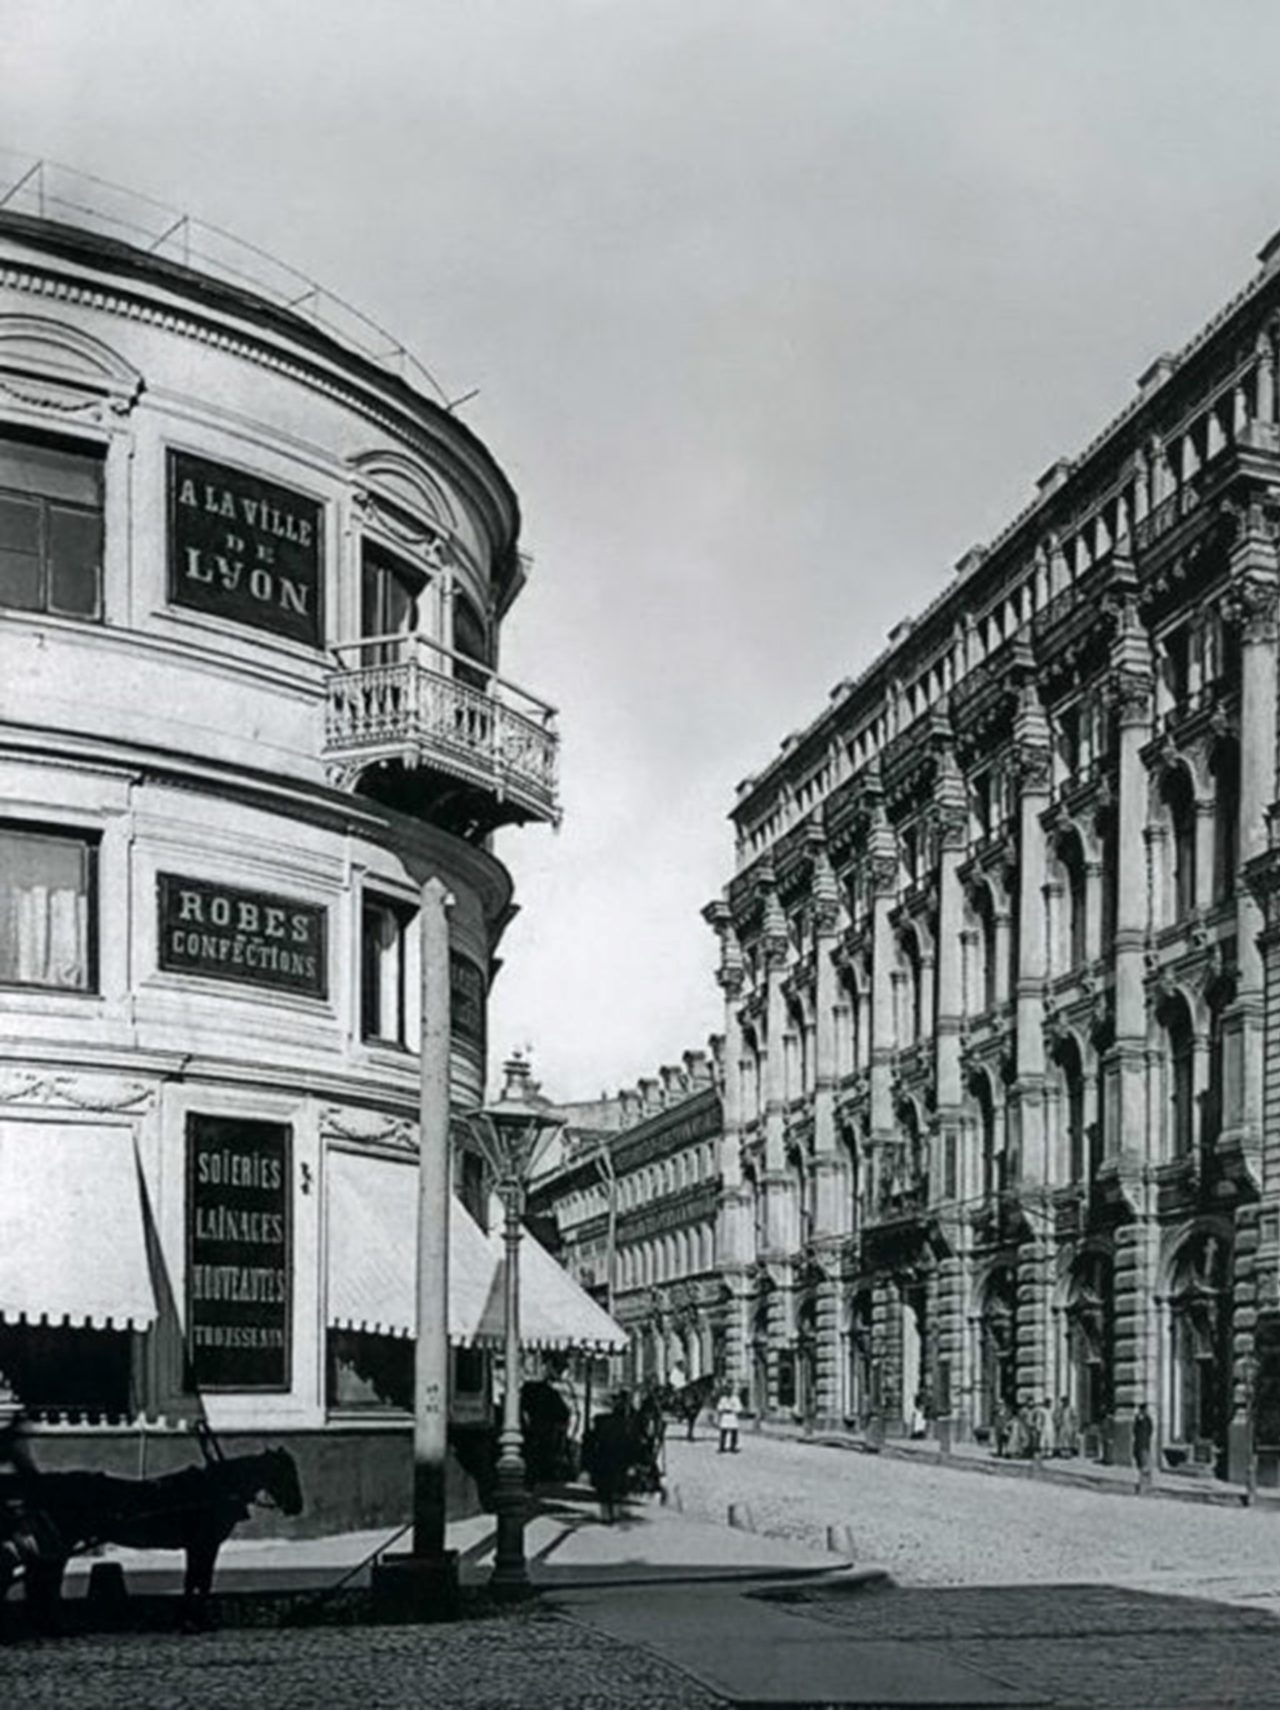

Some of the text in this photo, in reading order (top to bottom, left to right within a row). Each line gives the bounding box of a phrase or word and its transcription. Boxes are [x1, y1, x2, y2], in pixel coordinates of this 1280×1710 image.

[179, 478, 313, 548] A LA VILLE
[185, 546, 308, 616] LYON
[179, 891, 309, 942] ROBES
[172, 930, 317, 978] CONFECTIONS
[199, 1148, 281, 1189] SOIERIES
